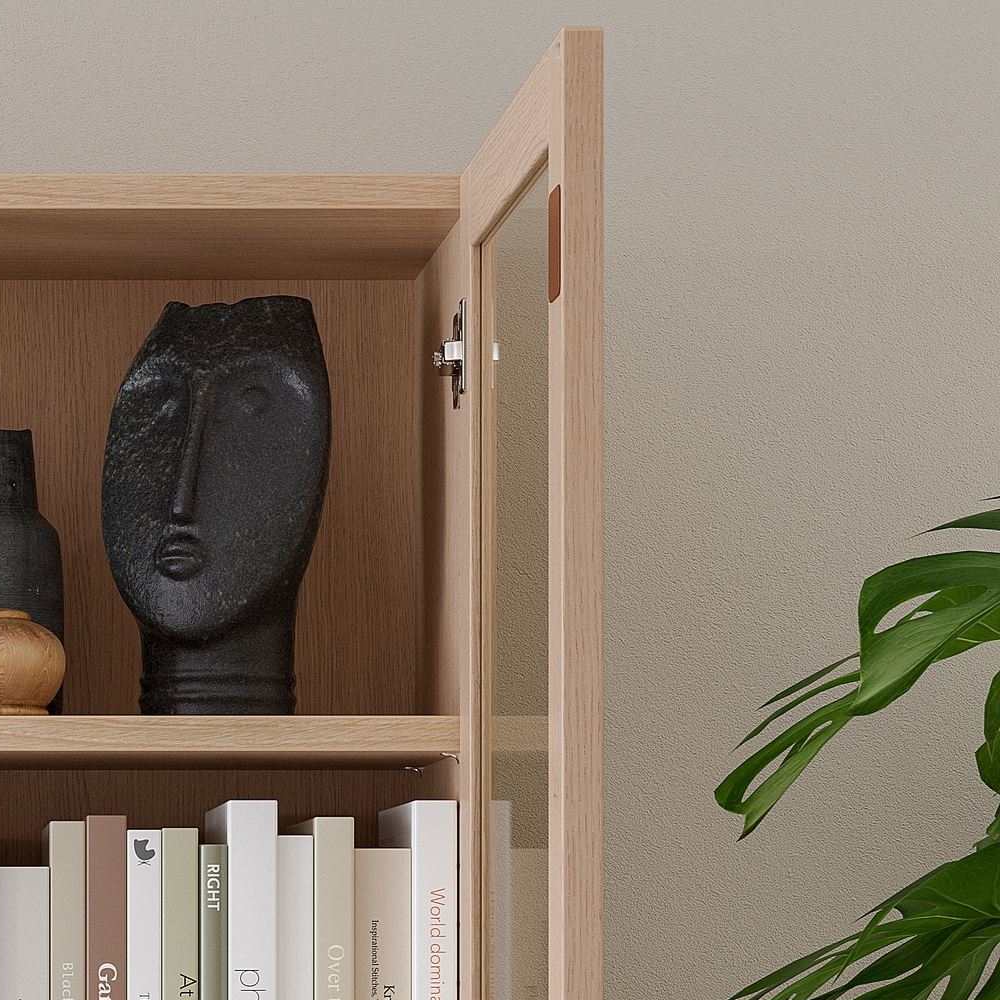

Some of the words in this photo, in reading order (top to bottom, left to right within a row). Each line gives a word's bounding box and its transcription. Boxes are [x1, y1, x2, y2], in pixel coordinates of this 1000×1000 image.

[206, 864, 220, 911] RIGHT
[429, 888, 446, 938] World
[370, 920, 380, 966] Inspirational
[179, 973, 198, 997] At
[327, 944, 345, 991] Over
[371, 967, 379, 997] Stitches,
